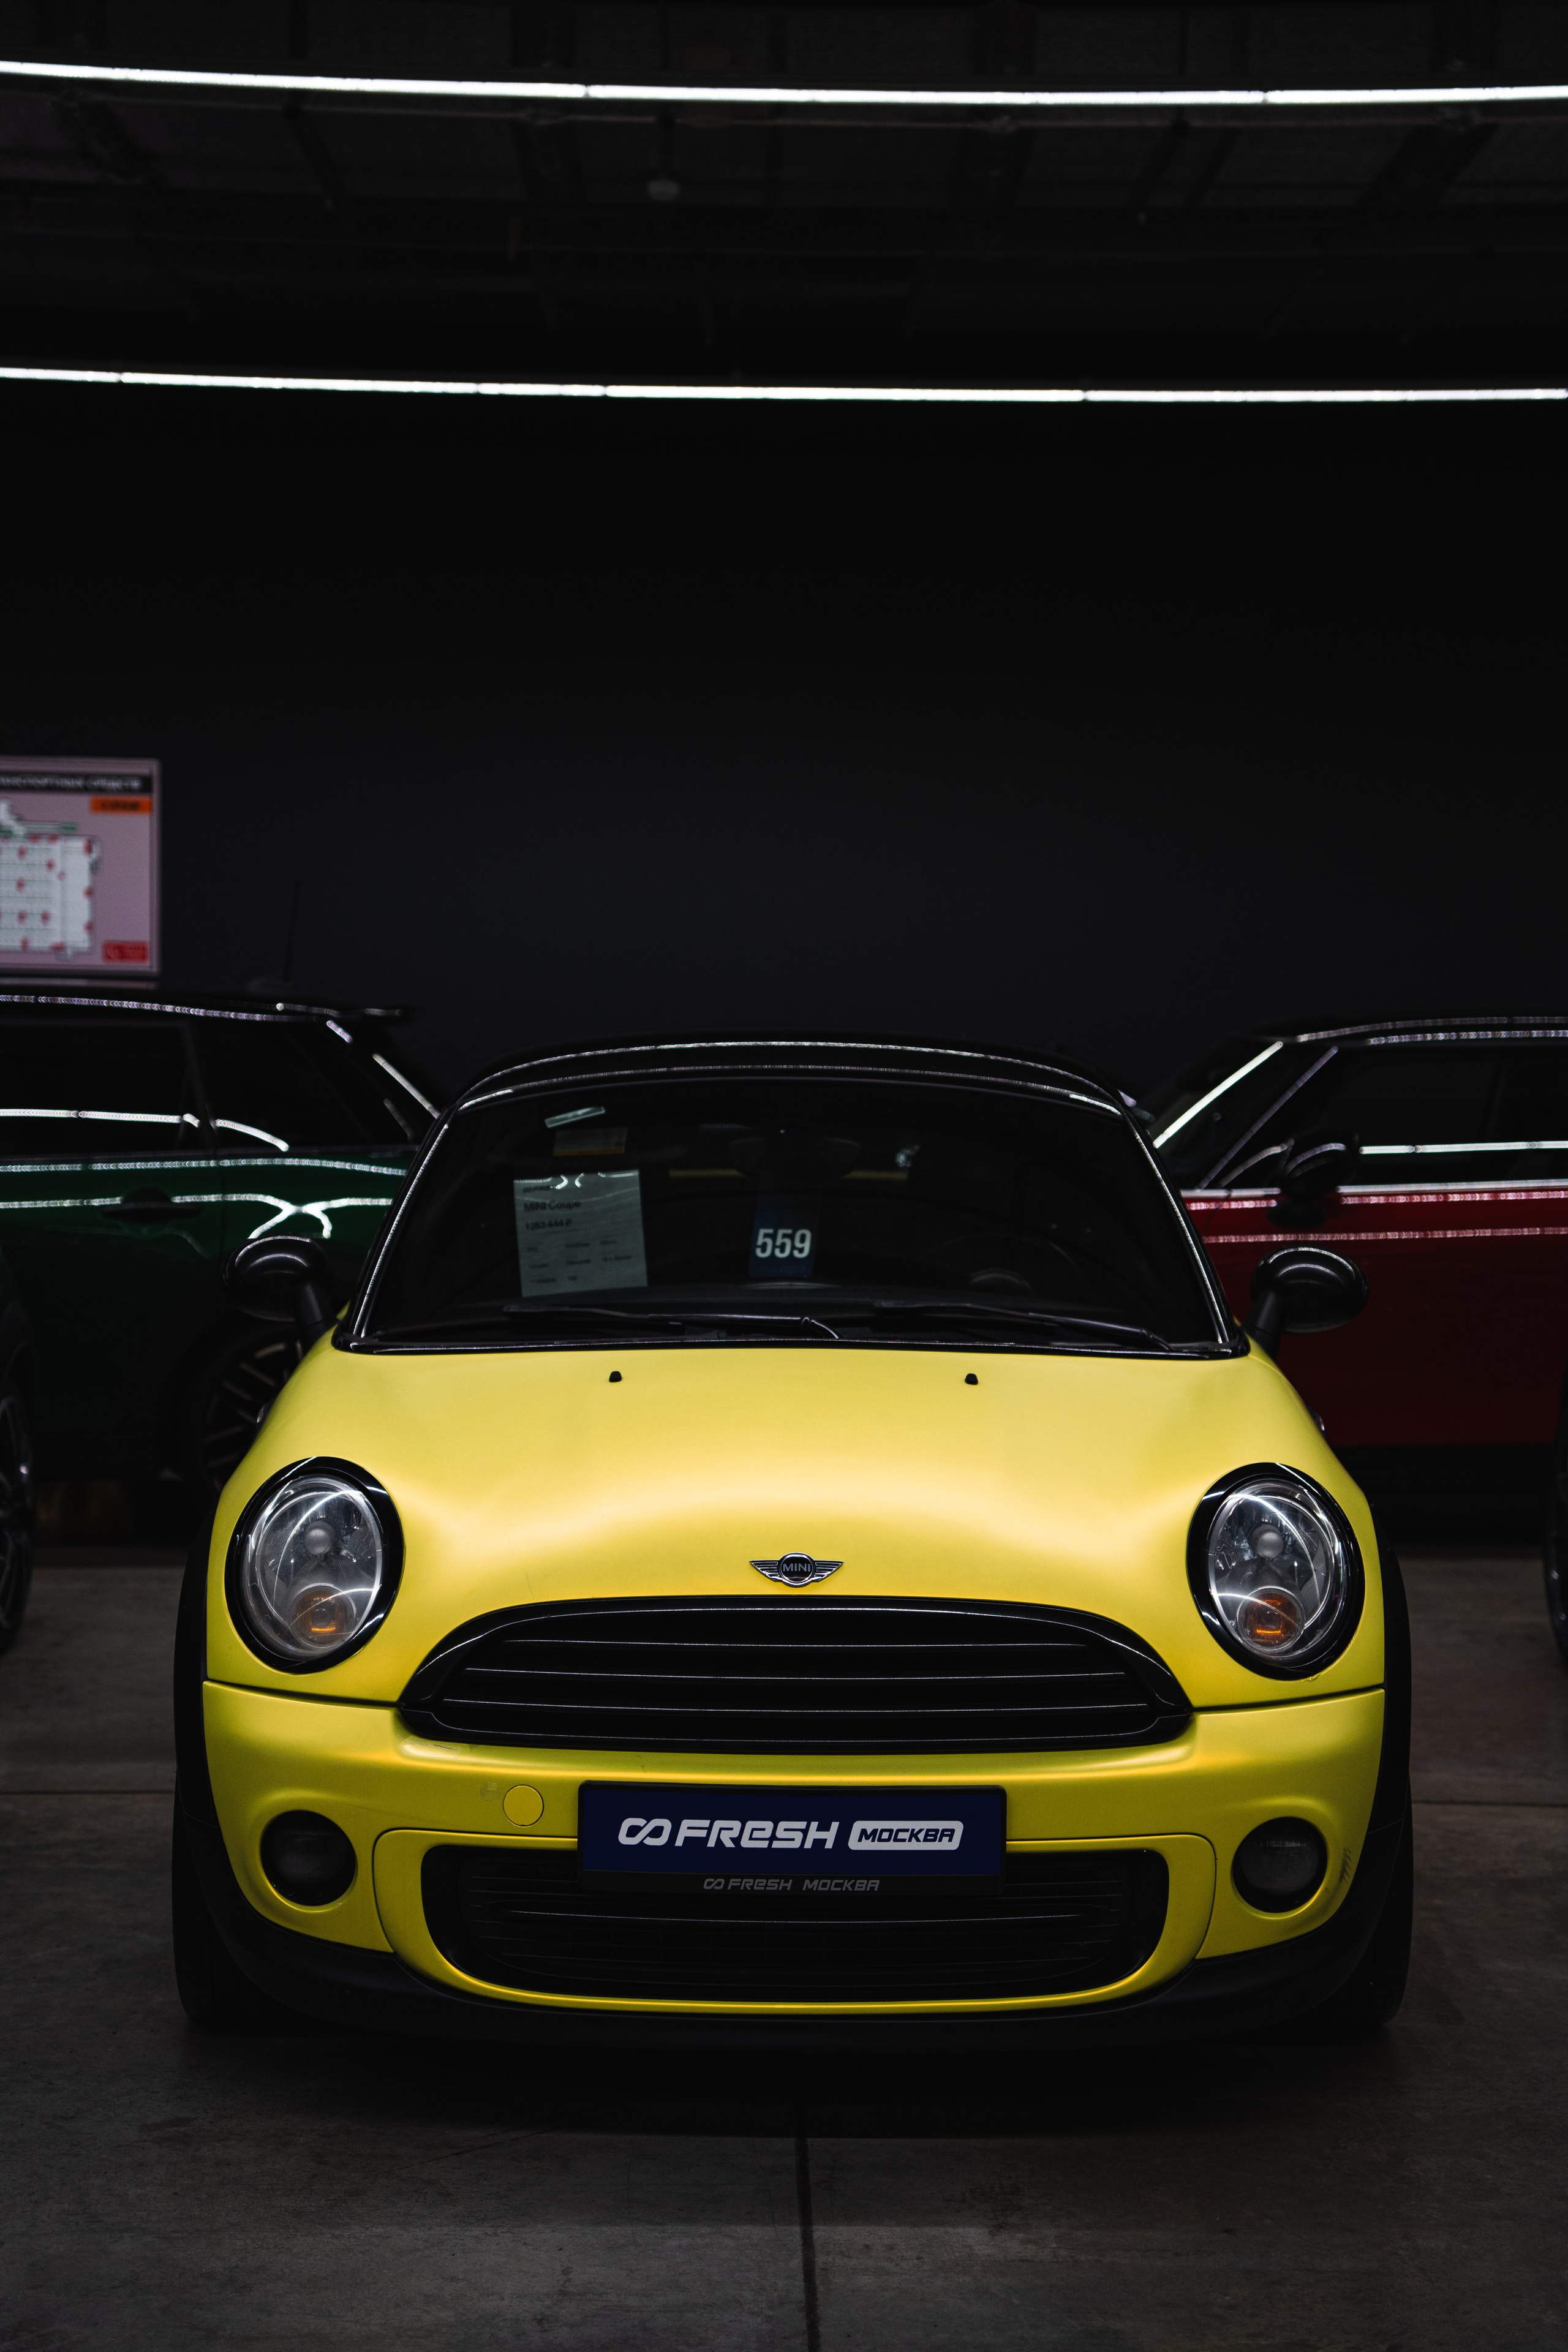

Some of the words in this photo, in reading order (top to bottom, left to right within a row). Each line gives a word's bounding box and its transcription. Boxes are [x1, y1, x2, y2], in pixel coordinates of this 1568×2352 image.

[524, 1202, 546, 1213] MINI
[548, 1200, 581, 1211] Coupe
[755, 1228, 812, 1258] 559
[783, 1563, 810, 1572] MINI
[858, 1828, 956, 1842] МОСКВА
[802, 1879, 880, 1891] МОСКВА
